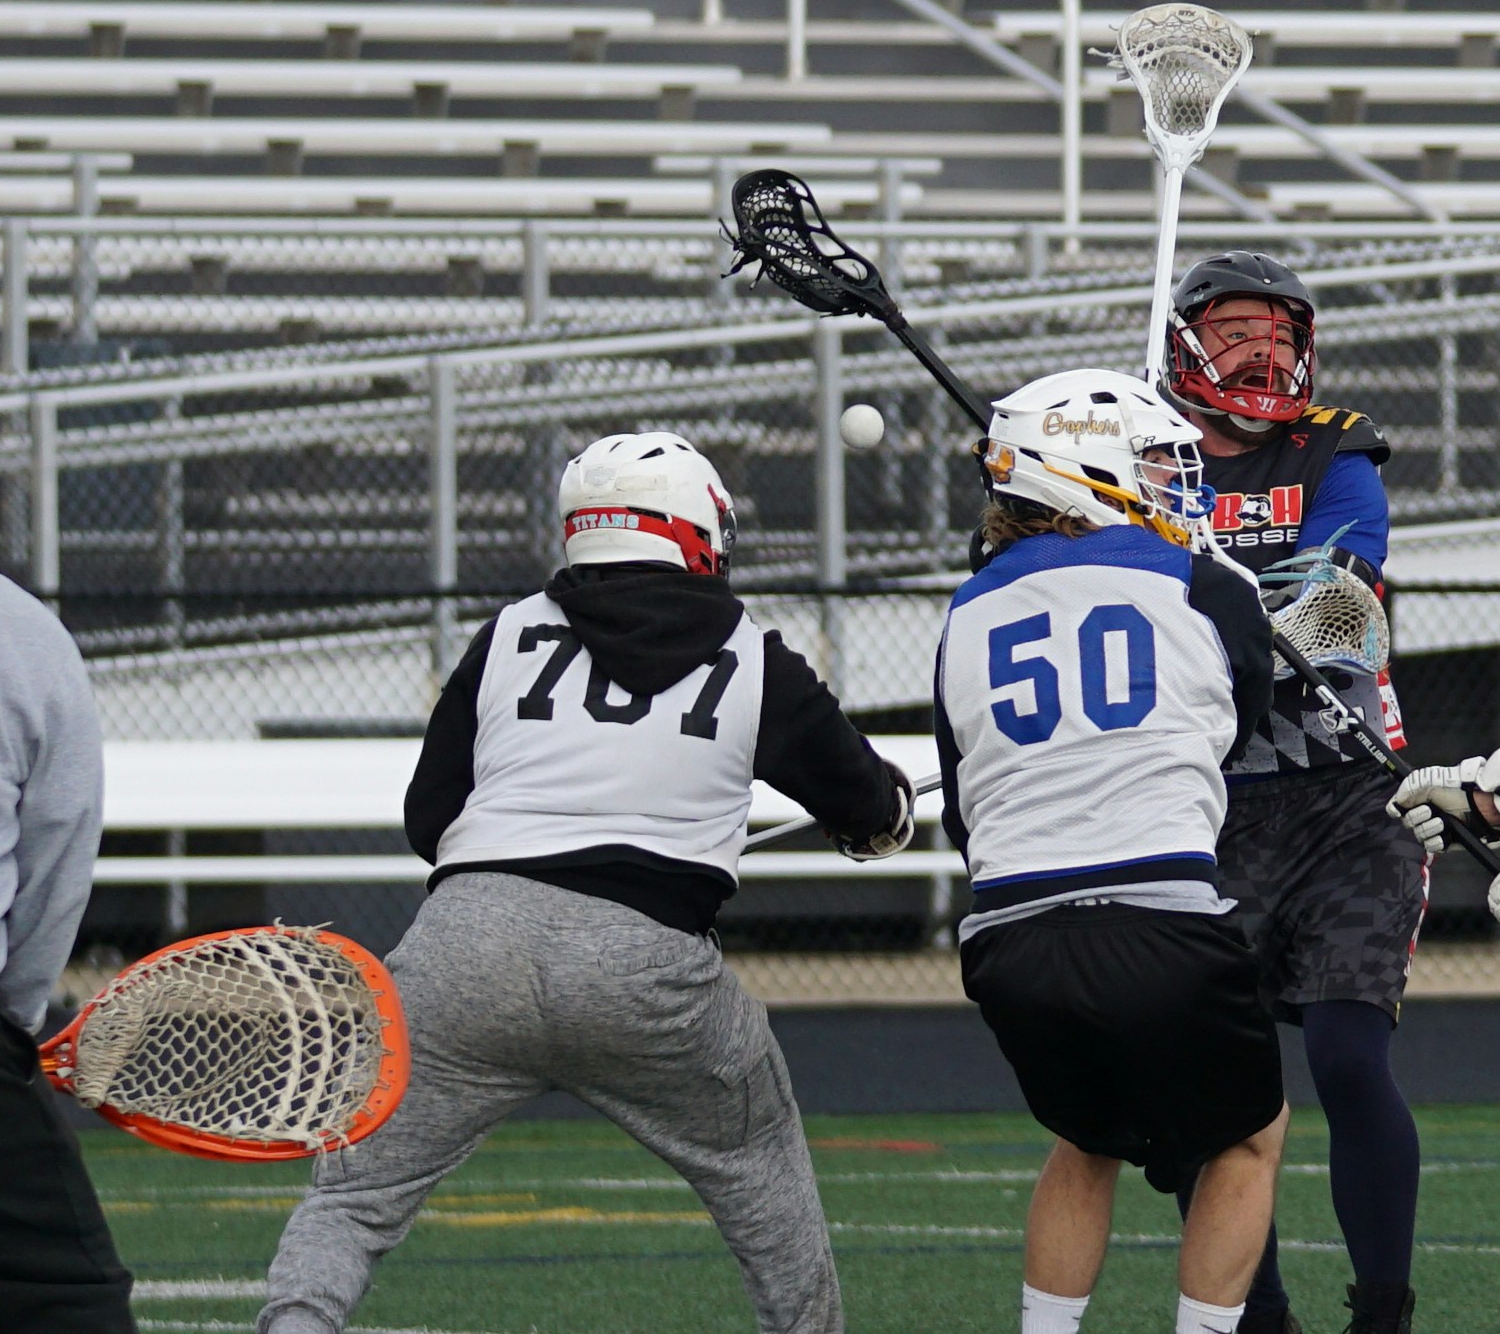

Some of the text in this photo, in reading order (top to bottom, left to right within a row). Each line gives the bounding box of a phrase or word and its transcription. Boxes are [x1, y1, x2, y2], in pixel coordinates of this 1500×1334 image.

[1043, 410, 1120, 444] Gophers
[572, 513, 639, 530] TITANS
[989, 604, 1157, 746] 50
[1354, 730, 1388, 764] STALLION
